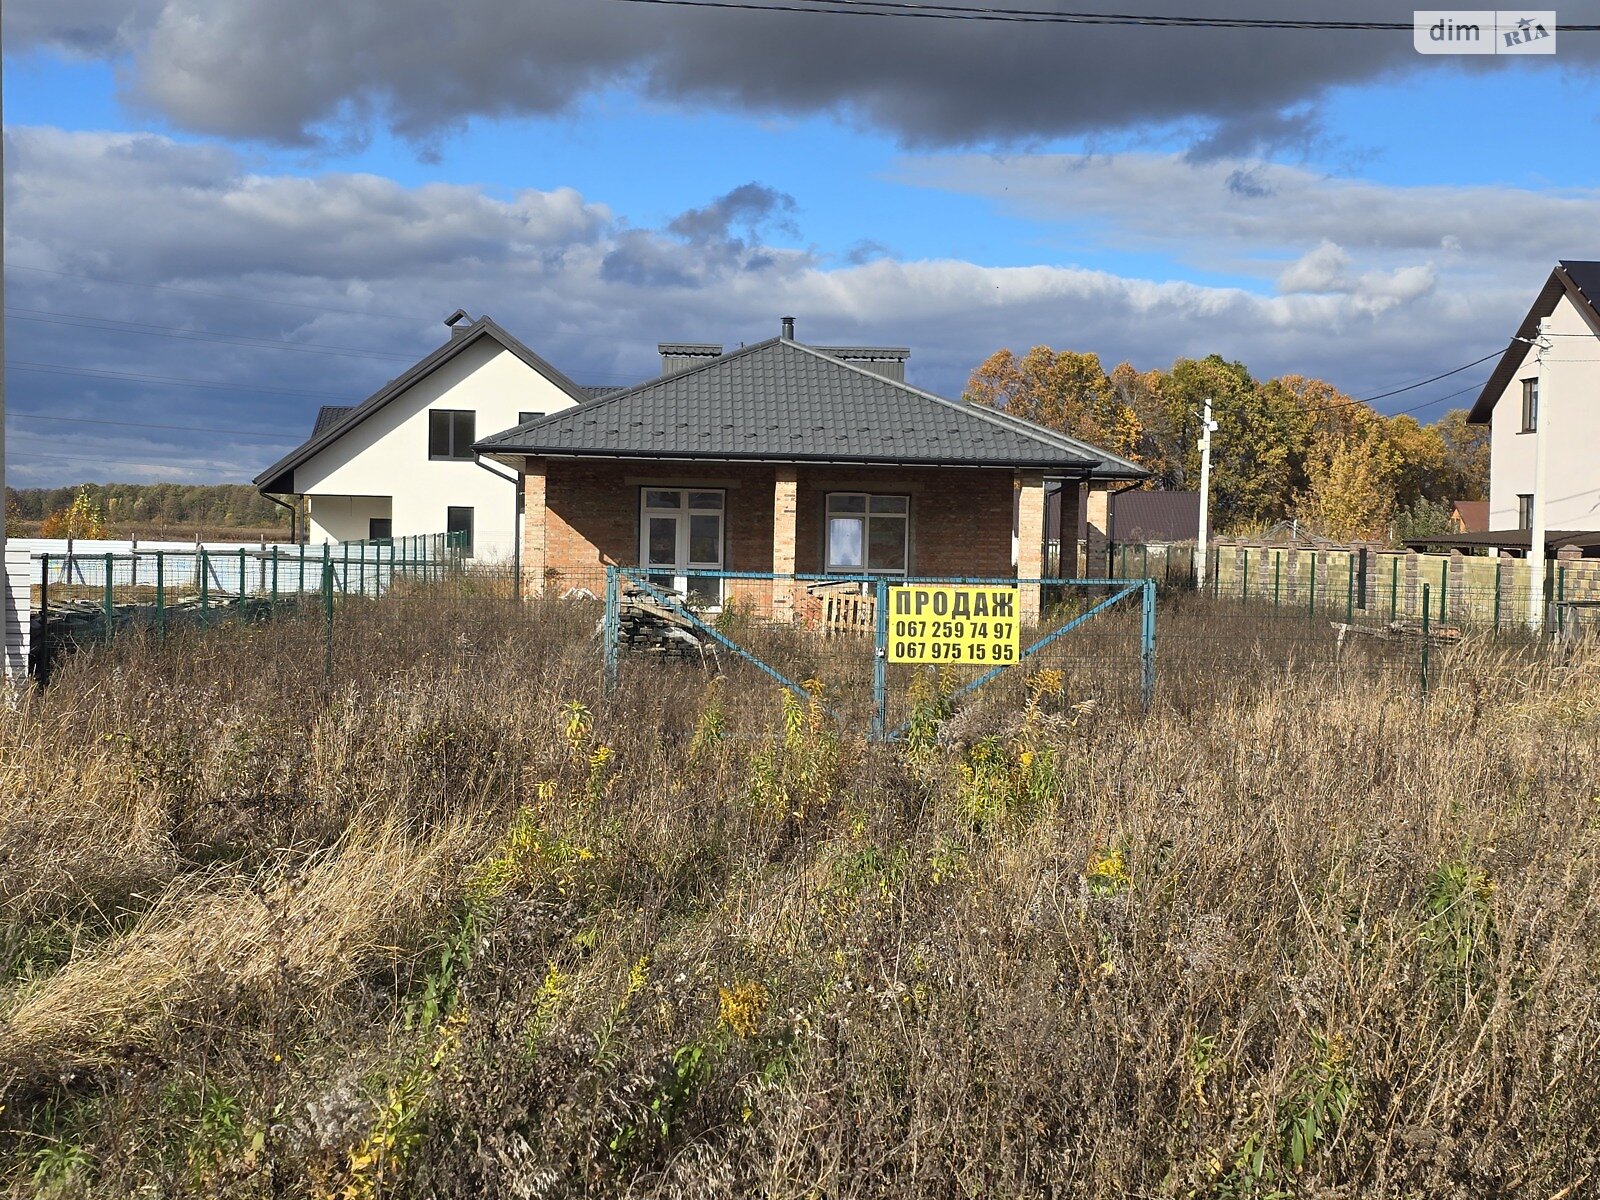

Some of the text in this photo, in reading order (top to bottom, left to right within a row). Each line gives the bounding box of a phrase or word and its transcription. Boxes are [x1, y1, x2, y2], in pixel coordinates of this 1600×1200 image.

[896, 591, 1013, 620] ПРОДАЖ
[896, 621, 1013, 639] 067 259 74 97
[895, 641, 1013, 660] 067 975 15 95
